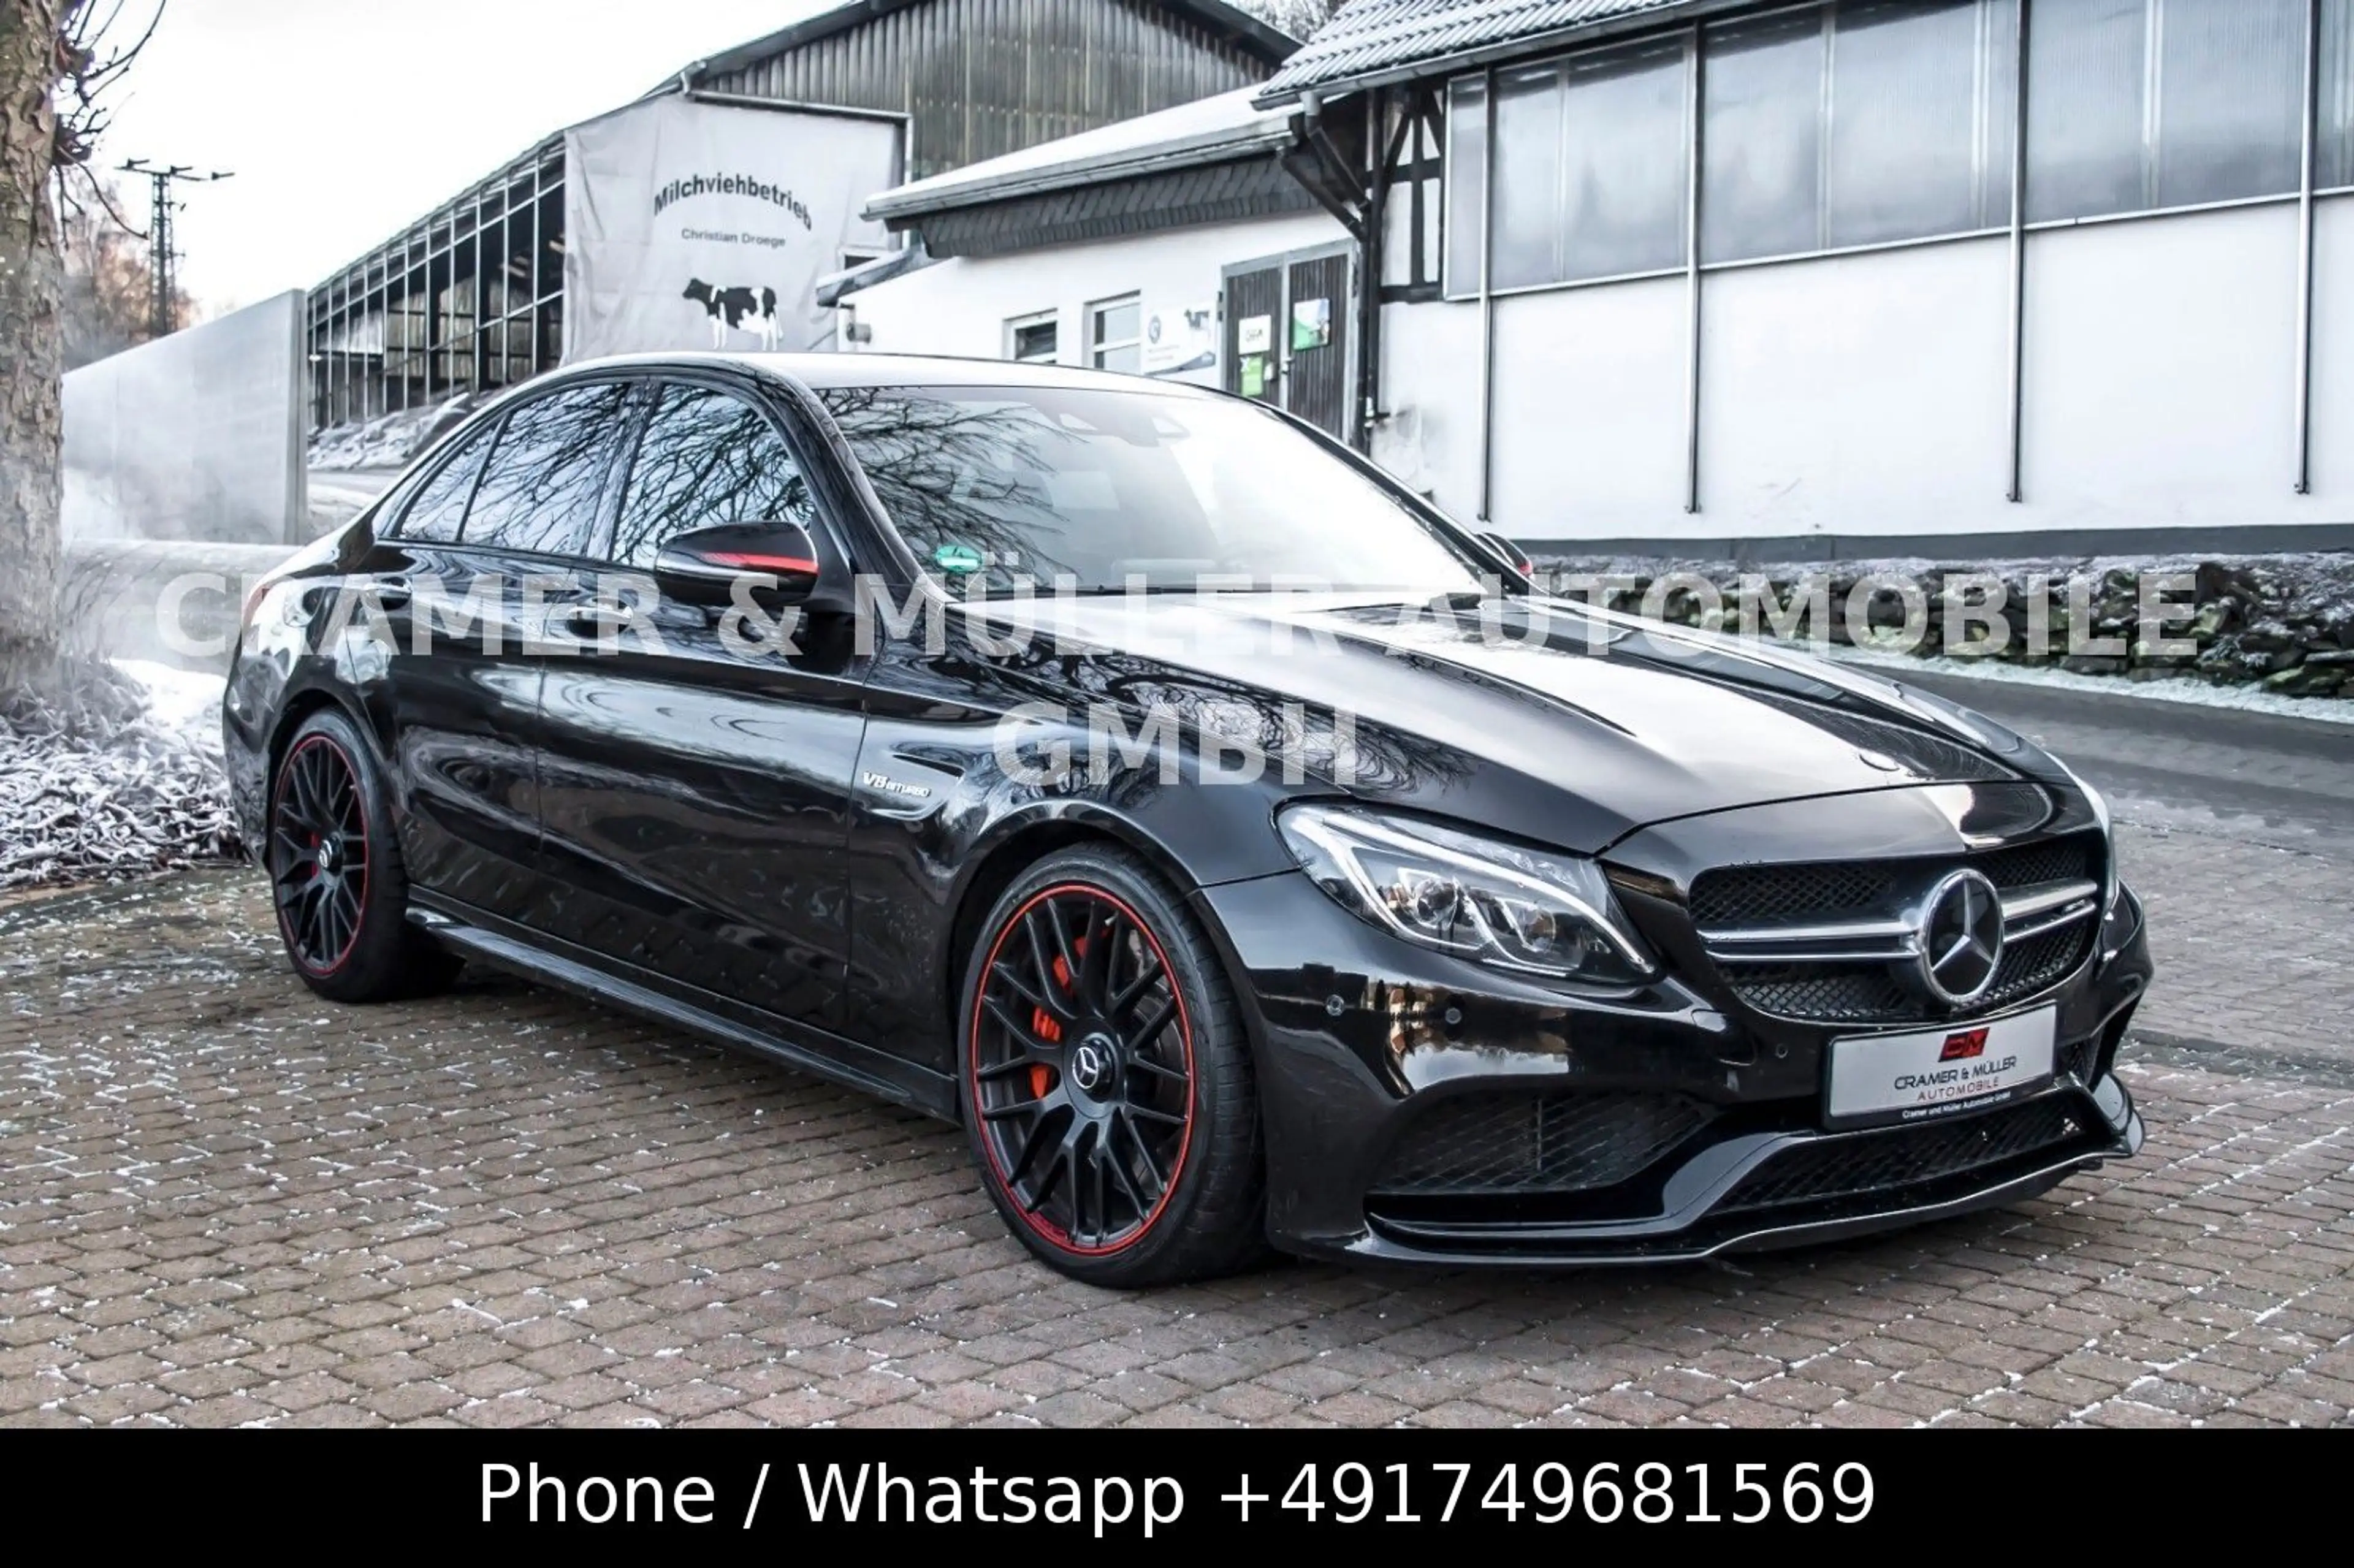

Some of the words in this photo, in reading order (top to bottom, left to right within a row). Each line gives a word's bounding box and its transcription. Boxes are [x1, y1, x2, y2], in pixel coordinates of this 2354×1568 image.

[654, 172, 812, 231] Milchviehbetrieb
[681, 227, 737, 244] Christian
[742, 233, 786, 249] Droege
[863, 772, 888, 788] V8
[1894, 1069, 1958, 1090] CRAMER
[1962, 1067, 1969, 1079] &
[1971, 1056, 2017, 1077] MÜLLER
[1917, 1076, 2000, 1102] AUTOMOBILE
